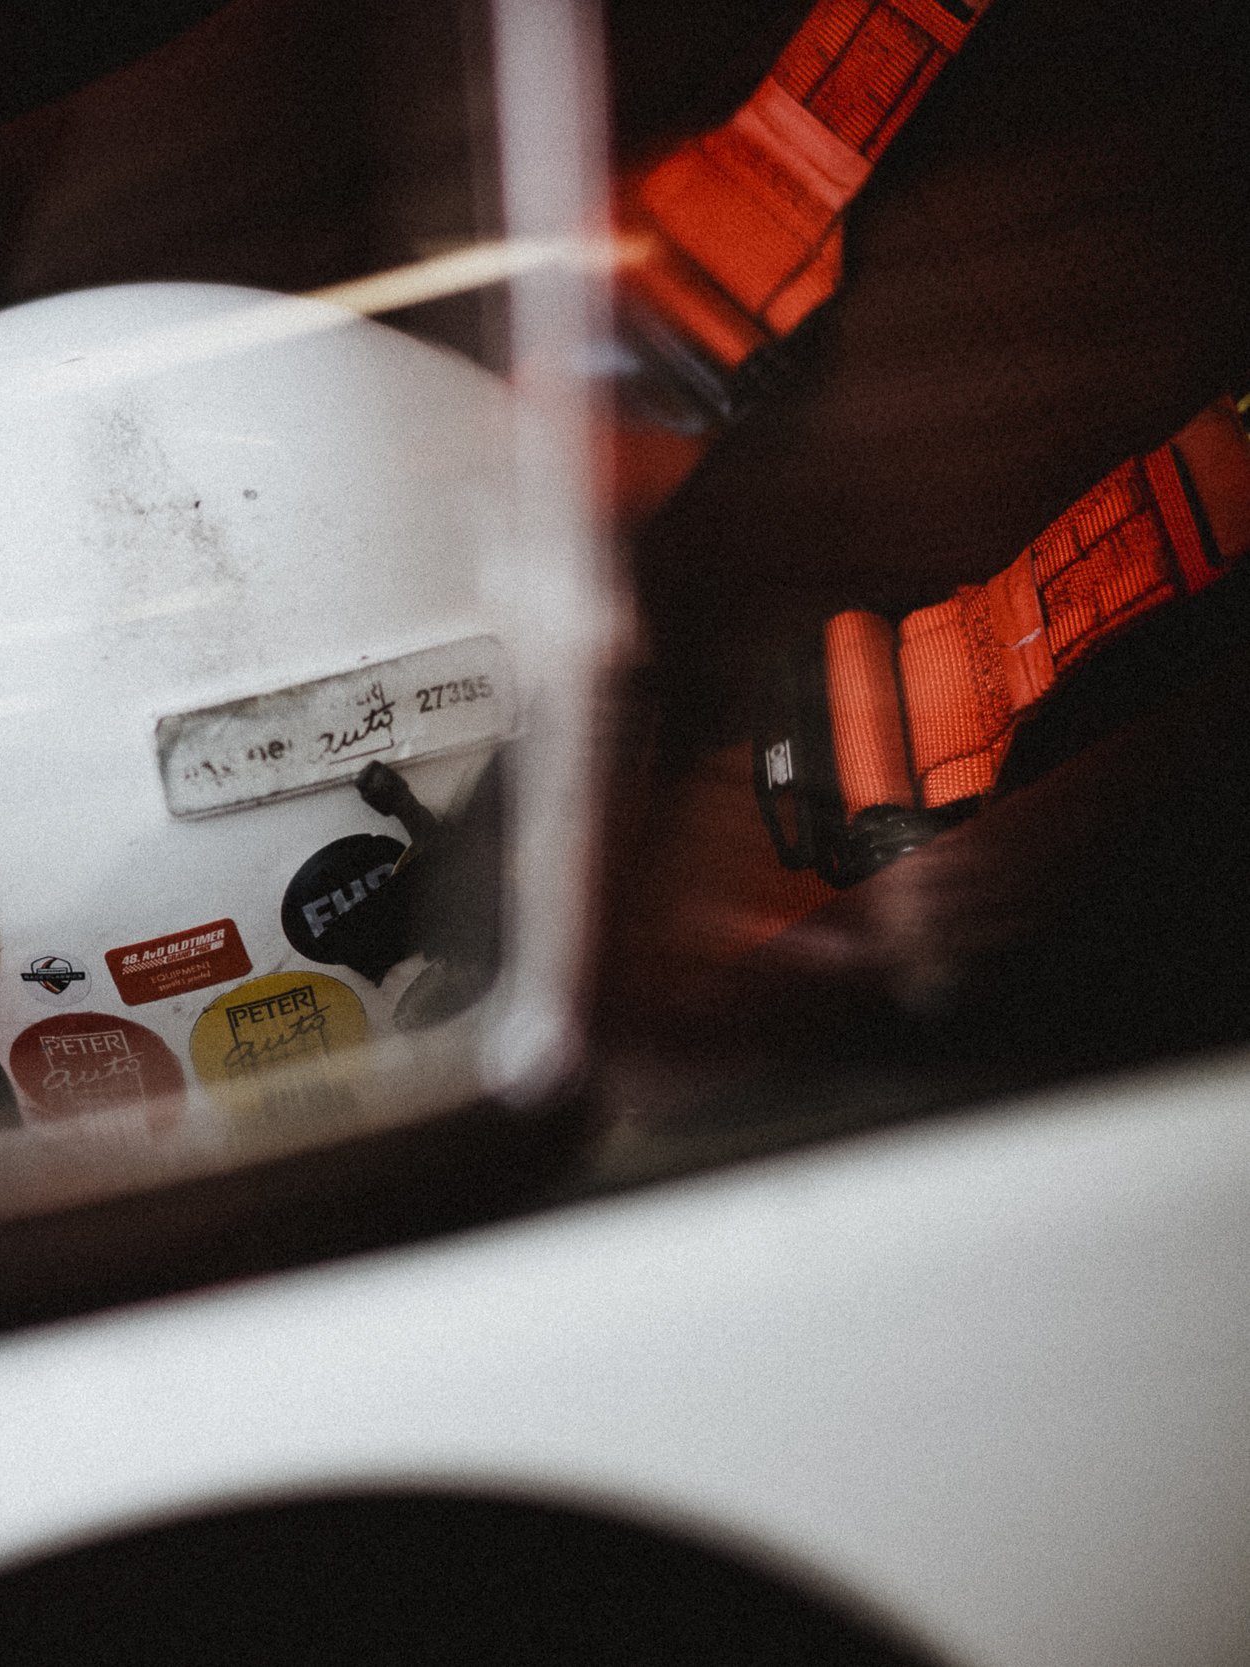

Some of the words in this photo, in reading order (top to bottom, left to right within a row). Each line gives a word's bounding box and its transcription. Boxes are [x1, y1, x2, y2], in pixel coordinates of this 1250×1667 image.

[121, 953, 141, 965] 48.
[142, 946, 165, 961] AvD
[167, 928, 225, 953] OLDTIMER
[150, 961, 212, 983] EQUIPMENT
[232, 991, 312, 1028] PETER
[44, 1034, 126, 1056] PETER
[224, 1005, 331, 1067] auto
[42, 1052, 145, 1090] auto
